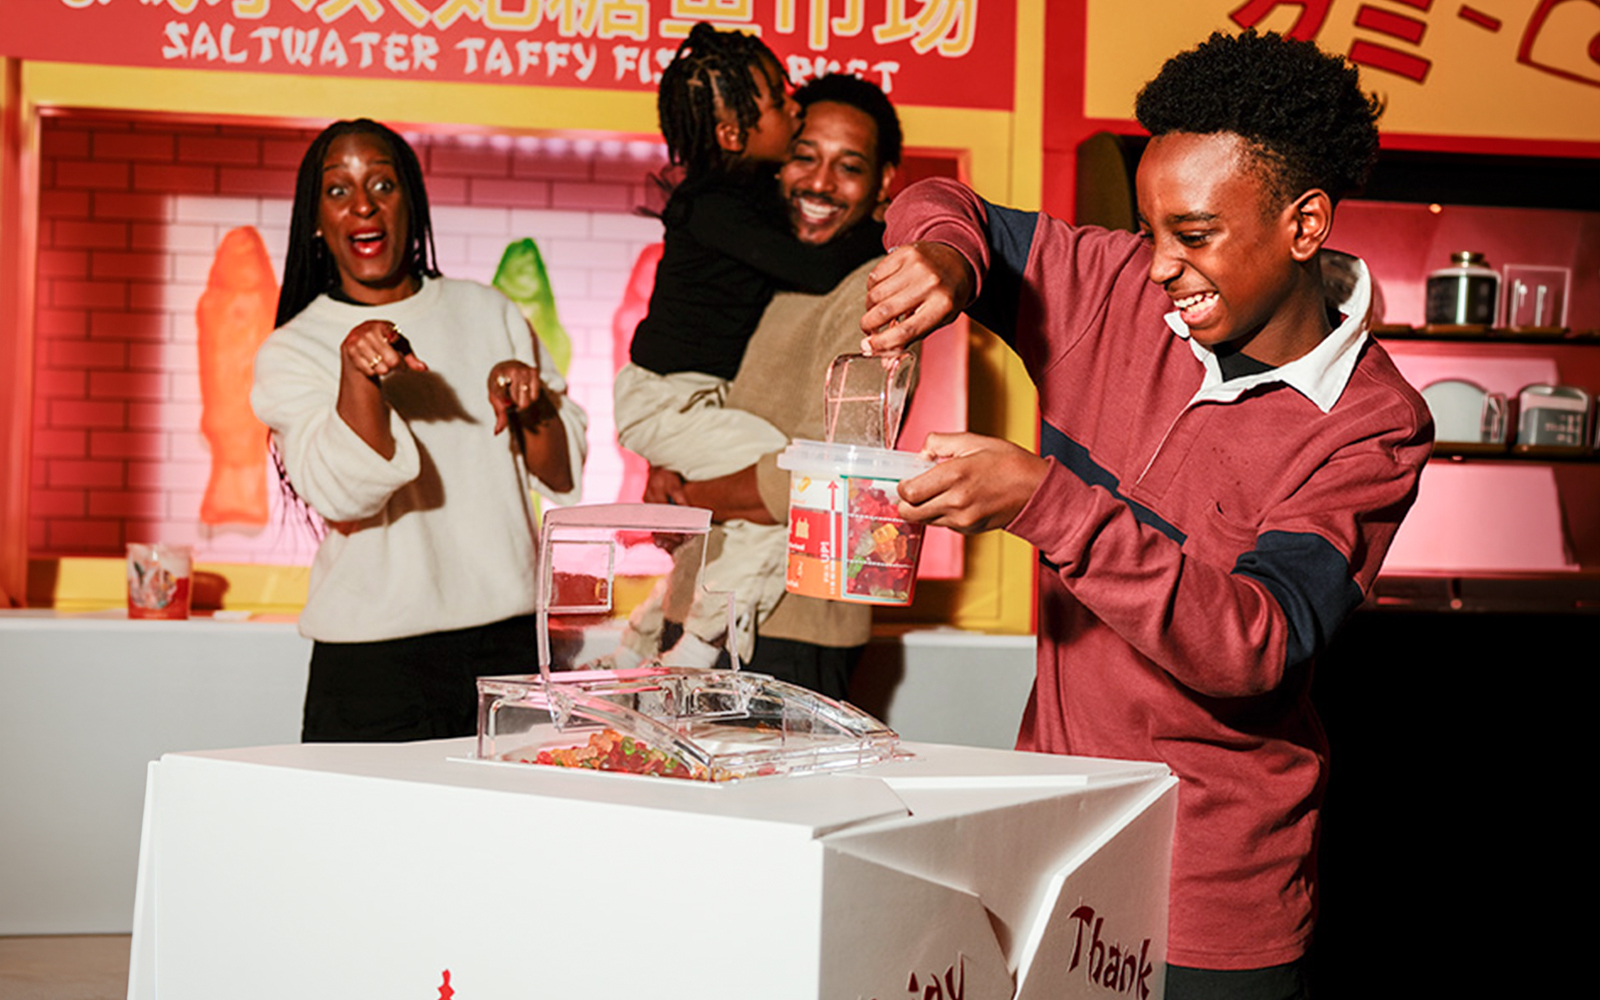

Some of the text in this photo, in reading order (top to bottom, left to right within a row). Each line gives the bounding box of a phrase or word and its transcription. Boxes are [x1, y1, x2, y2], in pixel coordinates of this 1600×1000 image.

[161, 19, 440, 73] SALTWATER
[455, 37, 597, 82] TAFFY
[1068, 905, 1153, 1000] Thank
